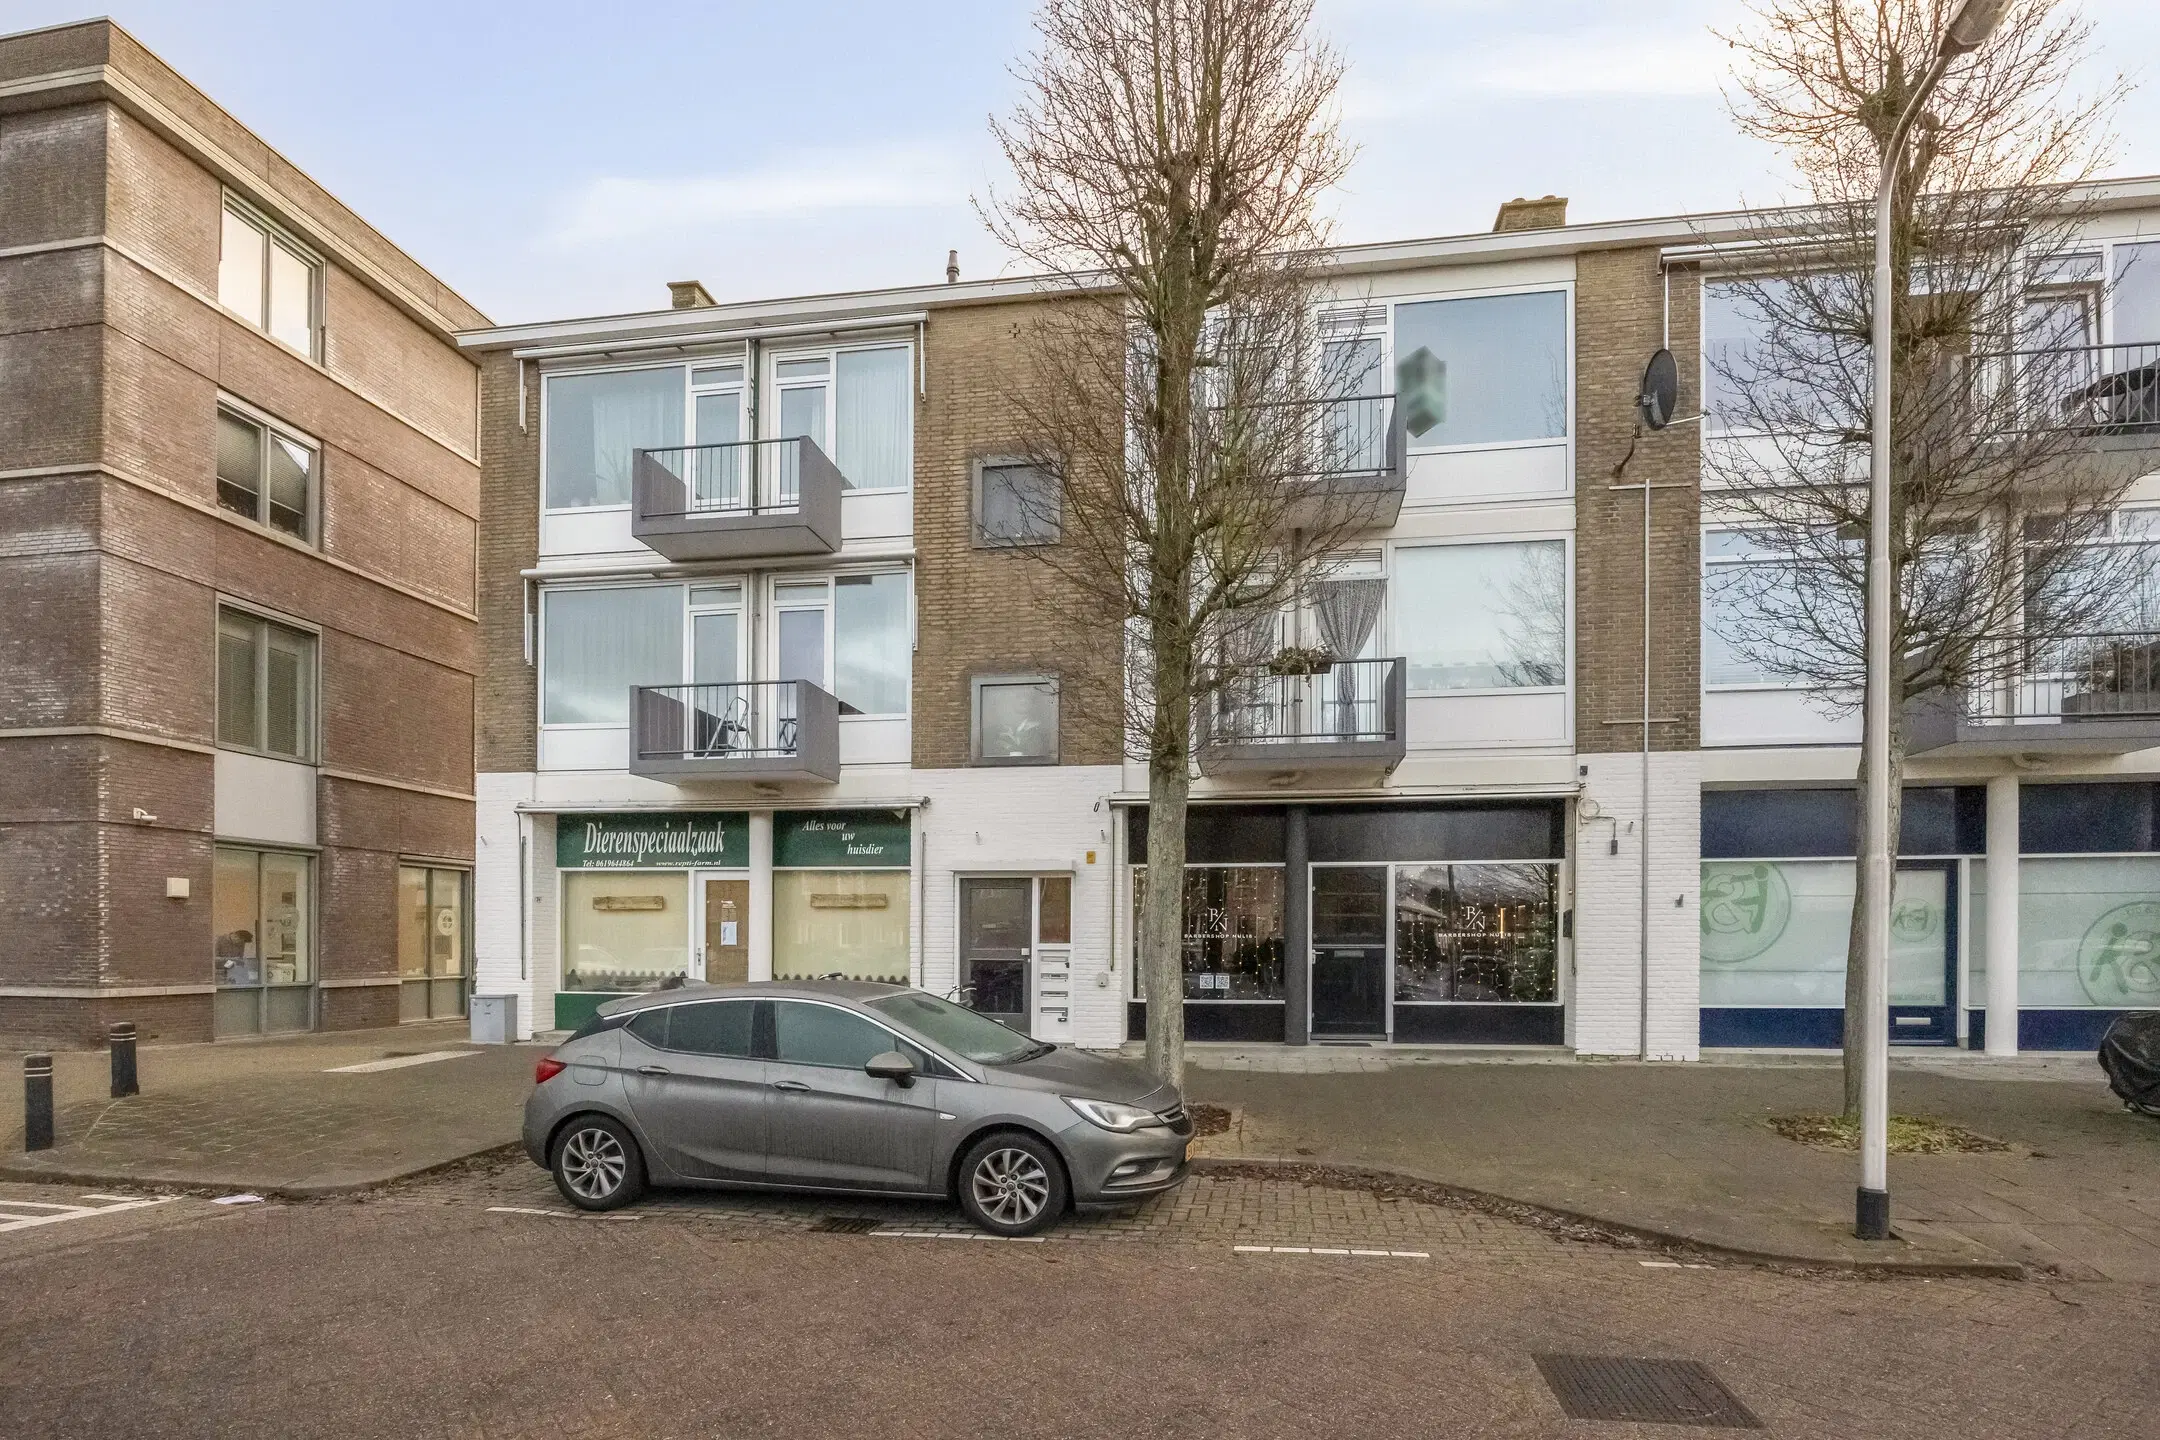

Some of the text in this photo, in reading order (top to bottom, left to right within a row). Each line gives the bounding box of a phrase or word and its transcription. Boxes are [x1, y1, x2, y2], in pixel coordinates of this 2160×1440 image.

[802, 820, 847, 831] Alles voor
[584, 820, 725, 863] Dierenspeciaalzaak
[841, 832, 856, 841] uw
[847, 843, 884, 855] huisdier
